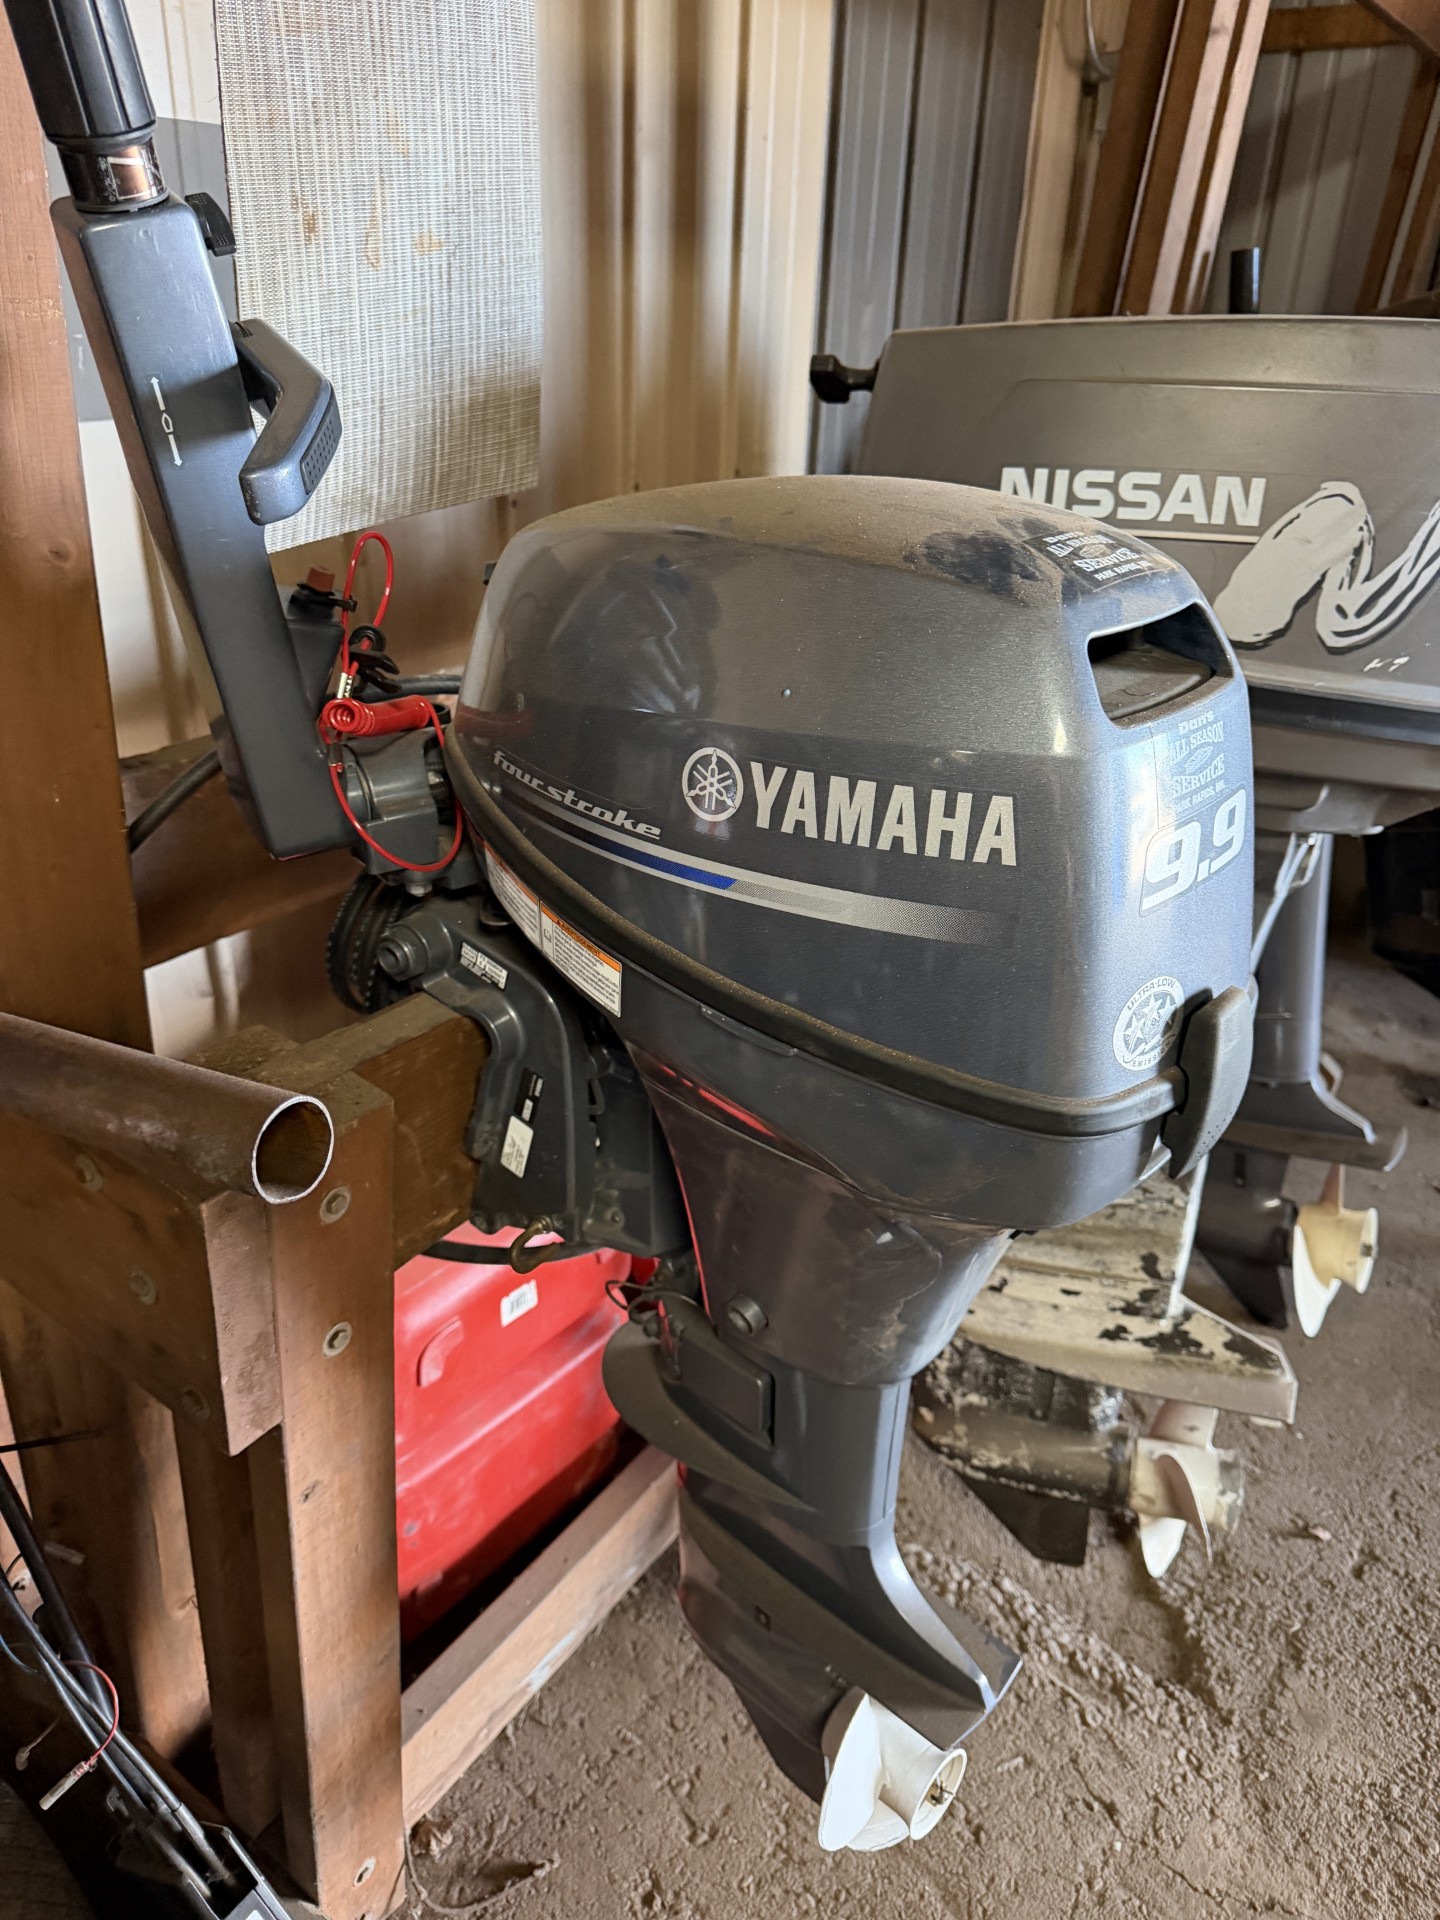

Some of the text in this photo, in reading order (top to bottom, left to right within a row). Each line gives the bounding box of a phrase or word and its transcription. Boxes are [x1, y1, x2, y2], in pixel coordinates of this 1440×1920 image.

[1000, 467, 1266, 526] NISSAN
[1073, 547, 1141, 572] SERVICE
[1178, 710, 1215, 735] Dan's
[1190, 721, 1224, 750] SEASON
[1172, 752, 1226, 798] SERVICE
[750, 761, 1017, 867] YAMAHA
[1141, 788, 1247, 911] 9.9
[1126, 977, 1177, 1011] ULTRA-LOW
